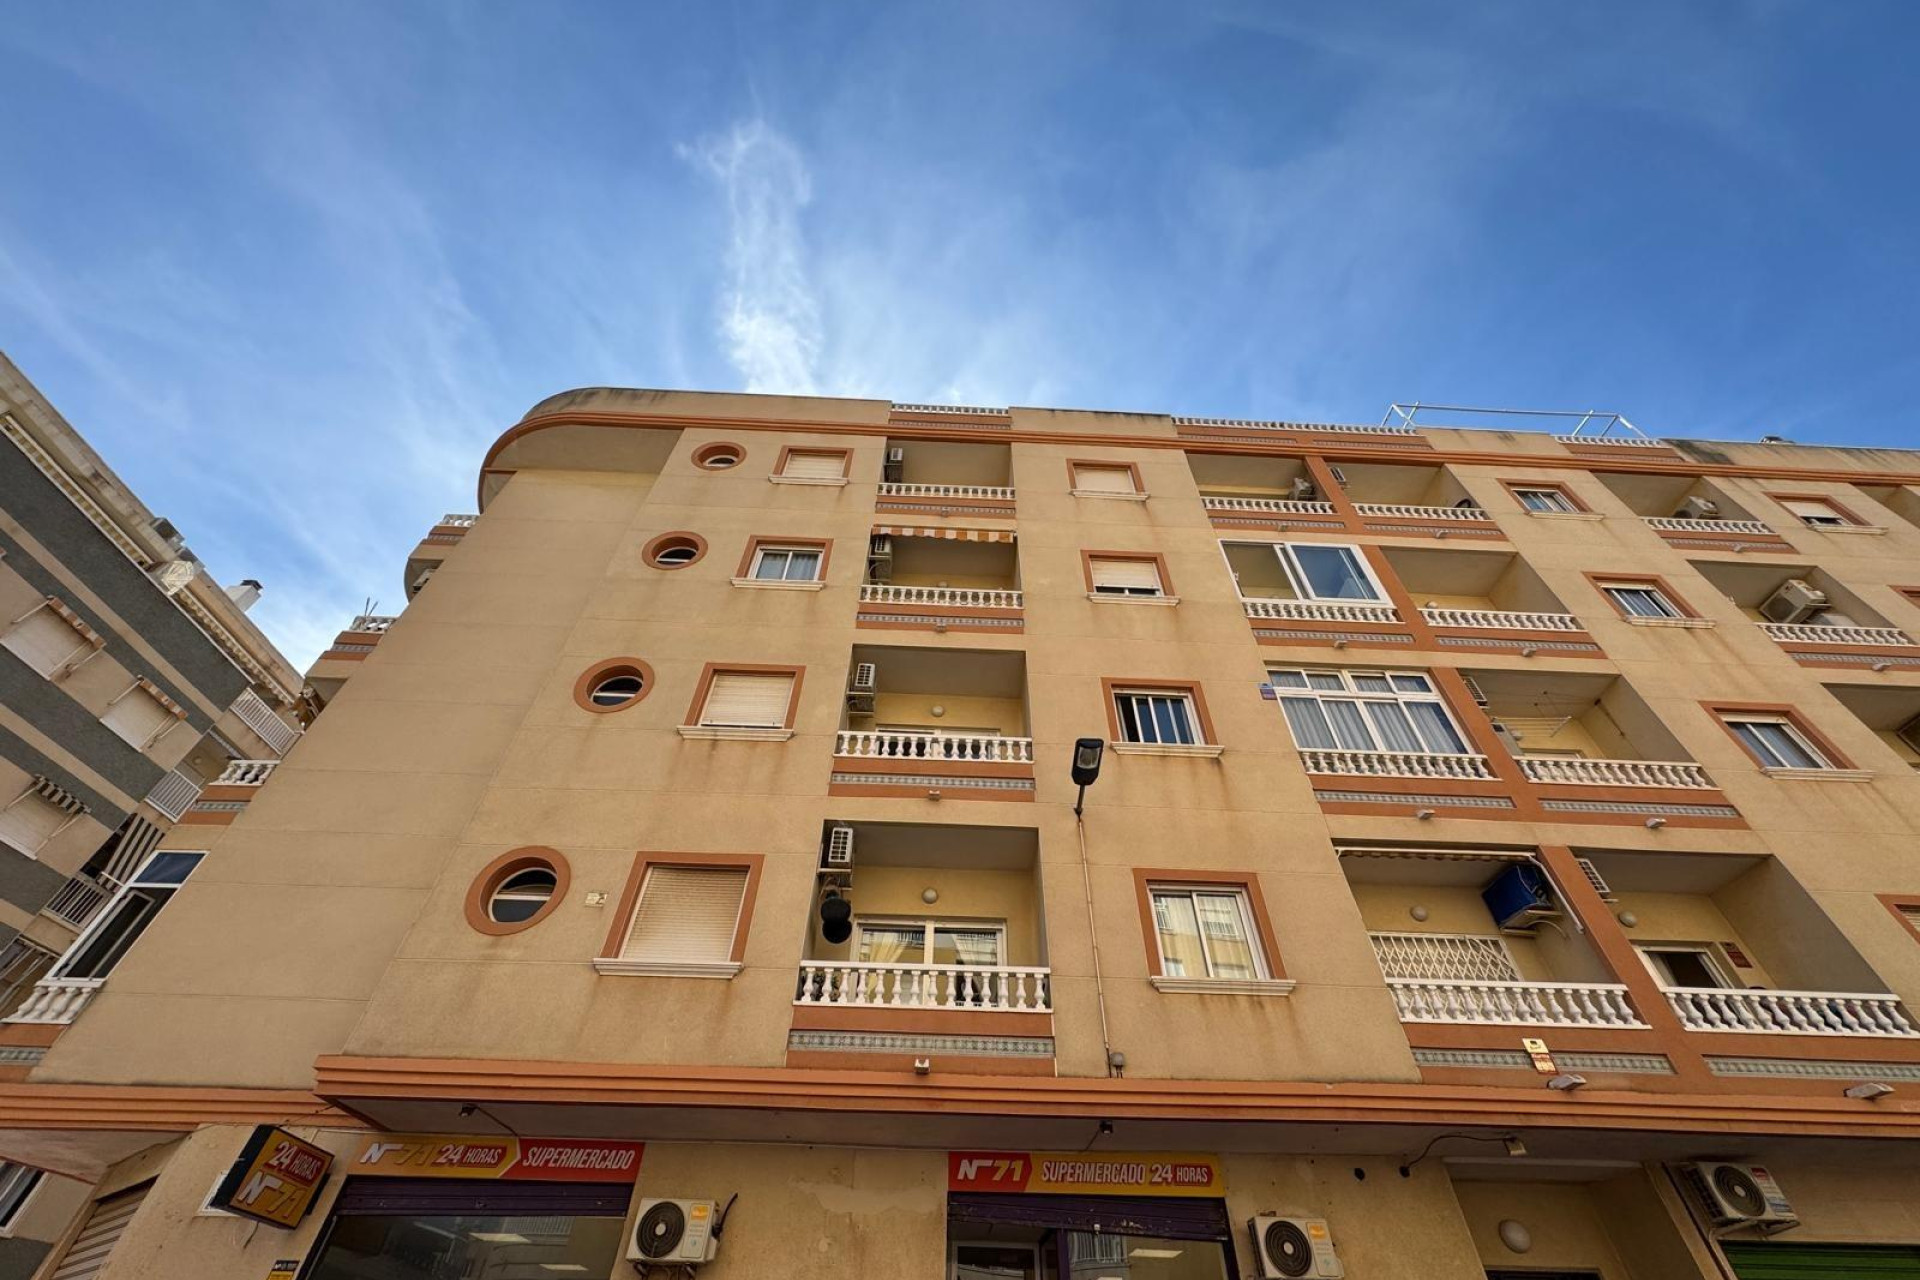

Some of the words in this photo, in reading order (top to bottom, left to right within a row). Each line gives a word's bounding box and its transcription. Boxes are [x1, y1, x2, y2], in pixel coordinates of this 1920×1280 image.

[266, 1141, 297, 1169] 24
[434, 1144, 465, 1164] 24
[462, 1149, 502, 1164] HORAS
[522, 1147, 636, 1170] SUPERMERCADO
[1042, 1161, 1146, 1184] SUPERMERCADO
[1150, 1164, 1173, 1183] 24
[1176, 1167, 1209, 1183] HORAS
